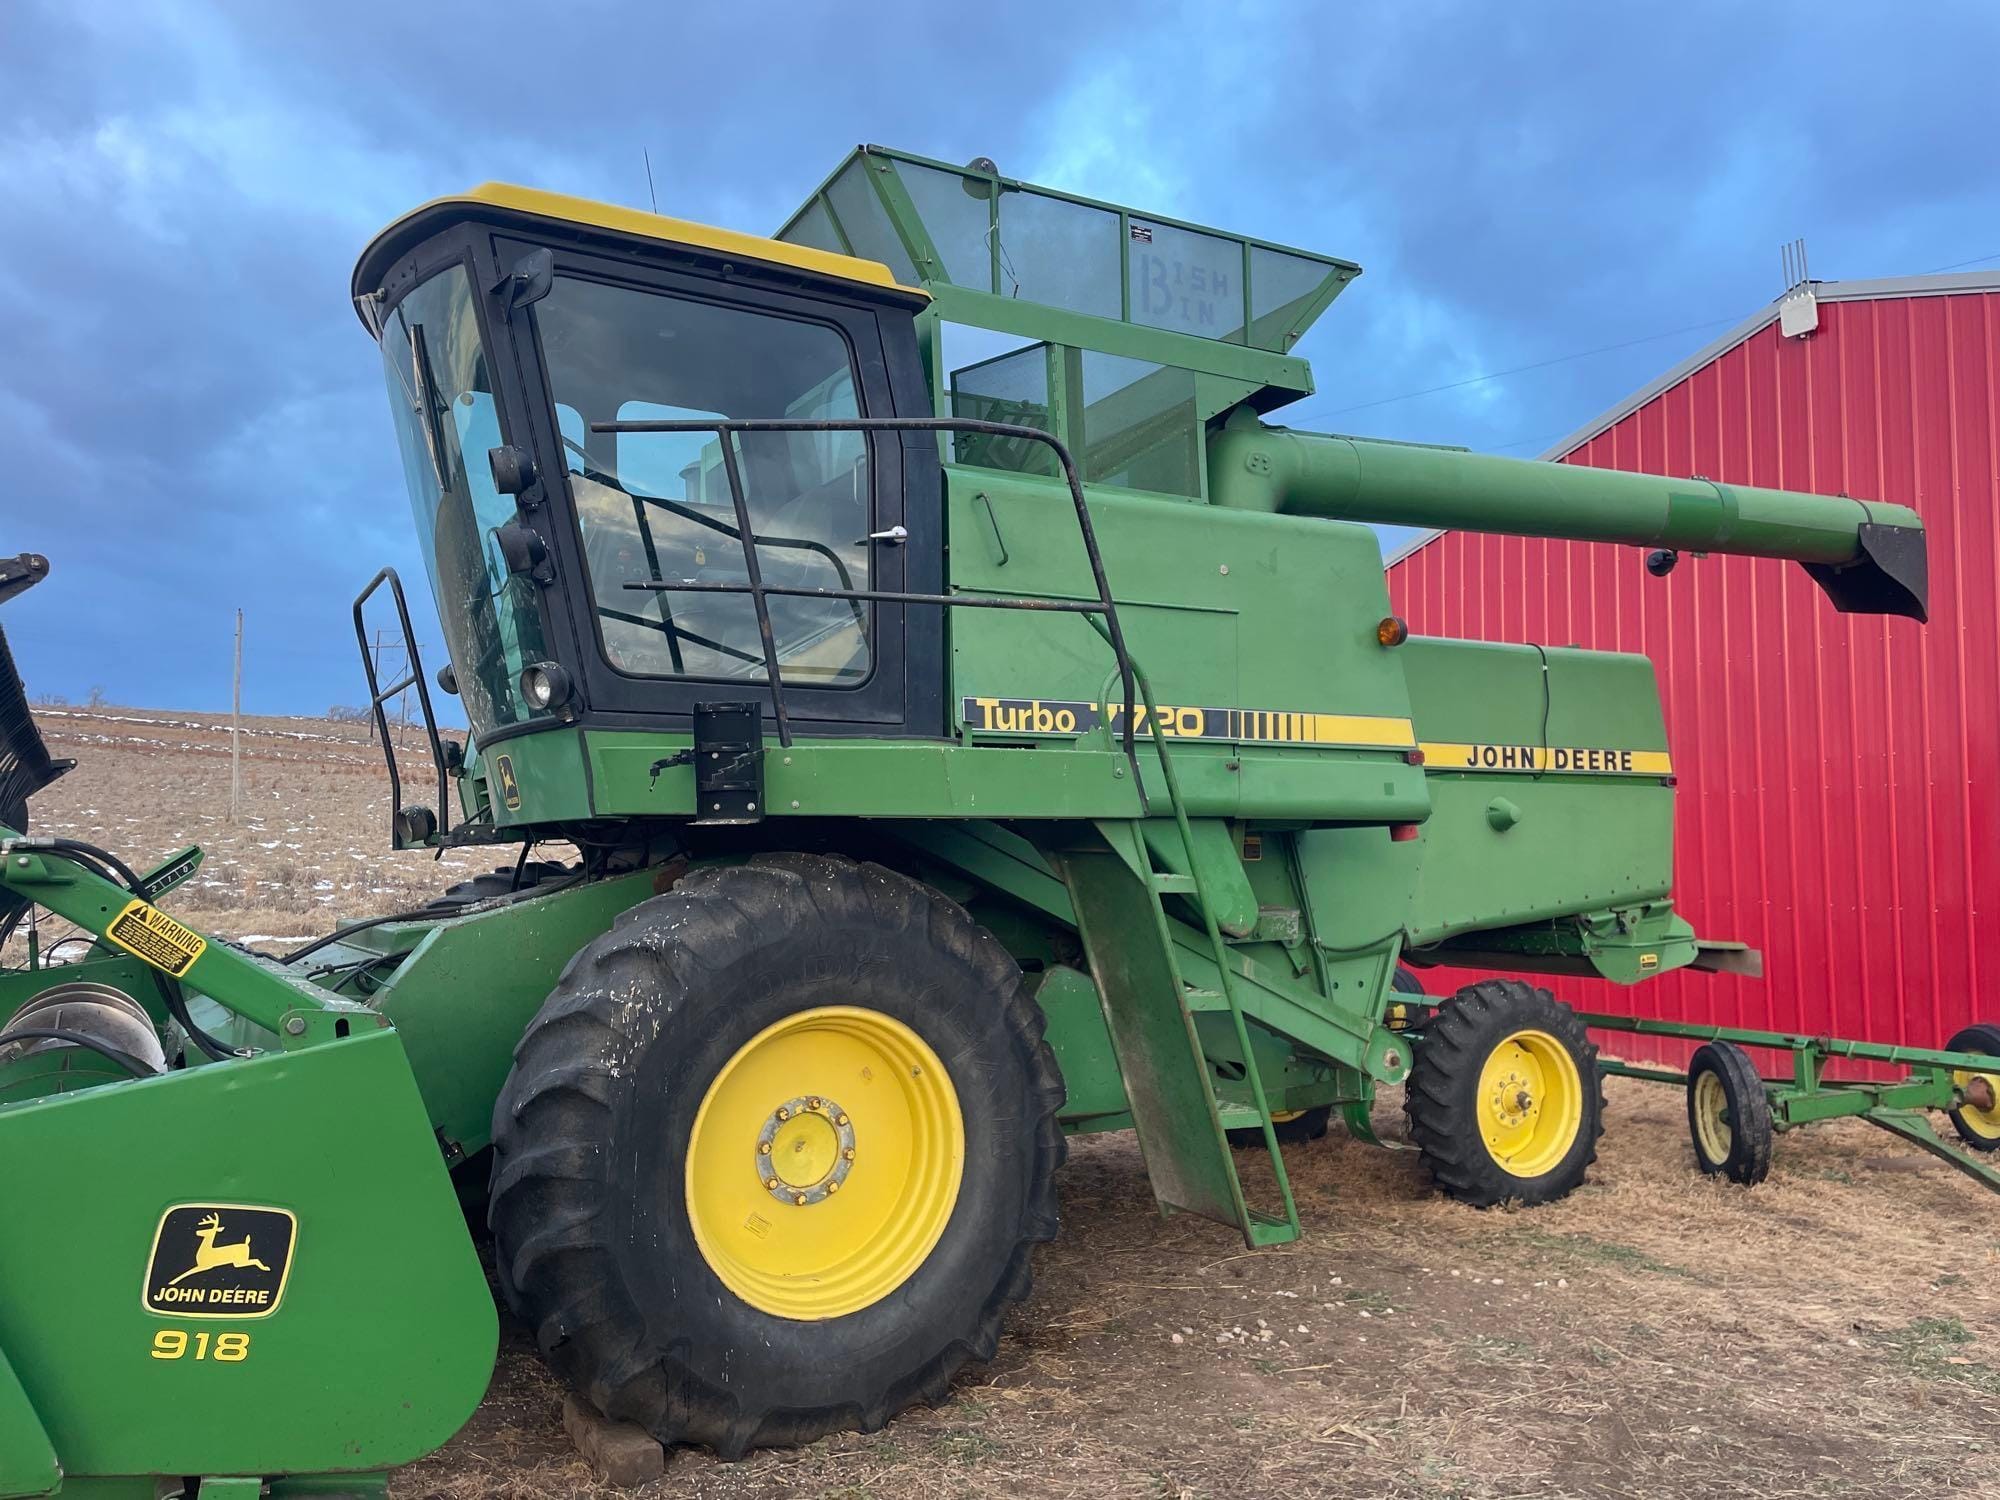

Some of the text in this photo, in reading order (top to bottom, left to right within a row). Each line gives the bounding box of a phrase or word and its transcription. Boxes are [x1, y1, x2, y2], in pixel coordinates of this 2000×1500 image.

[976, 698, 1076, 732] Turbo
[1467, 745, 1632, 771] JOHN DEERE
[148, 912, 203, 954] WARNING
[153, 1287, 269, 1304] JOHN DEERE
[151, 1329, 250, 1362] 918
